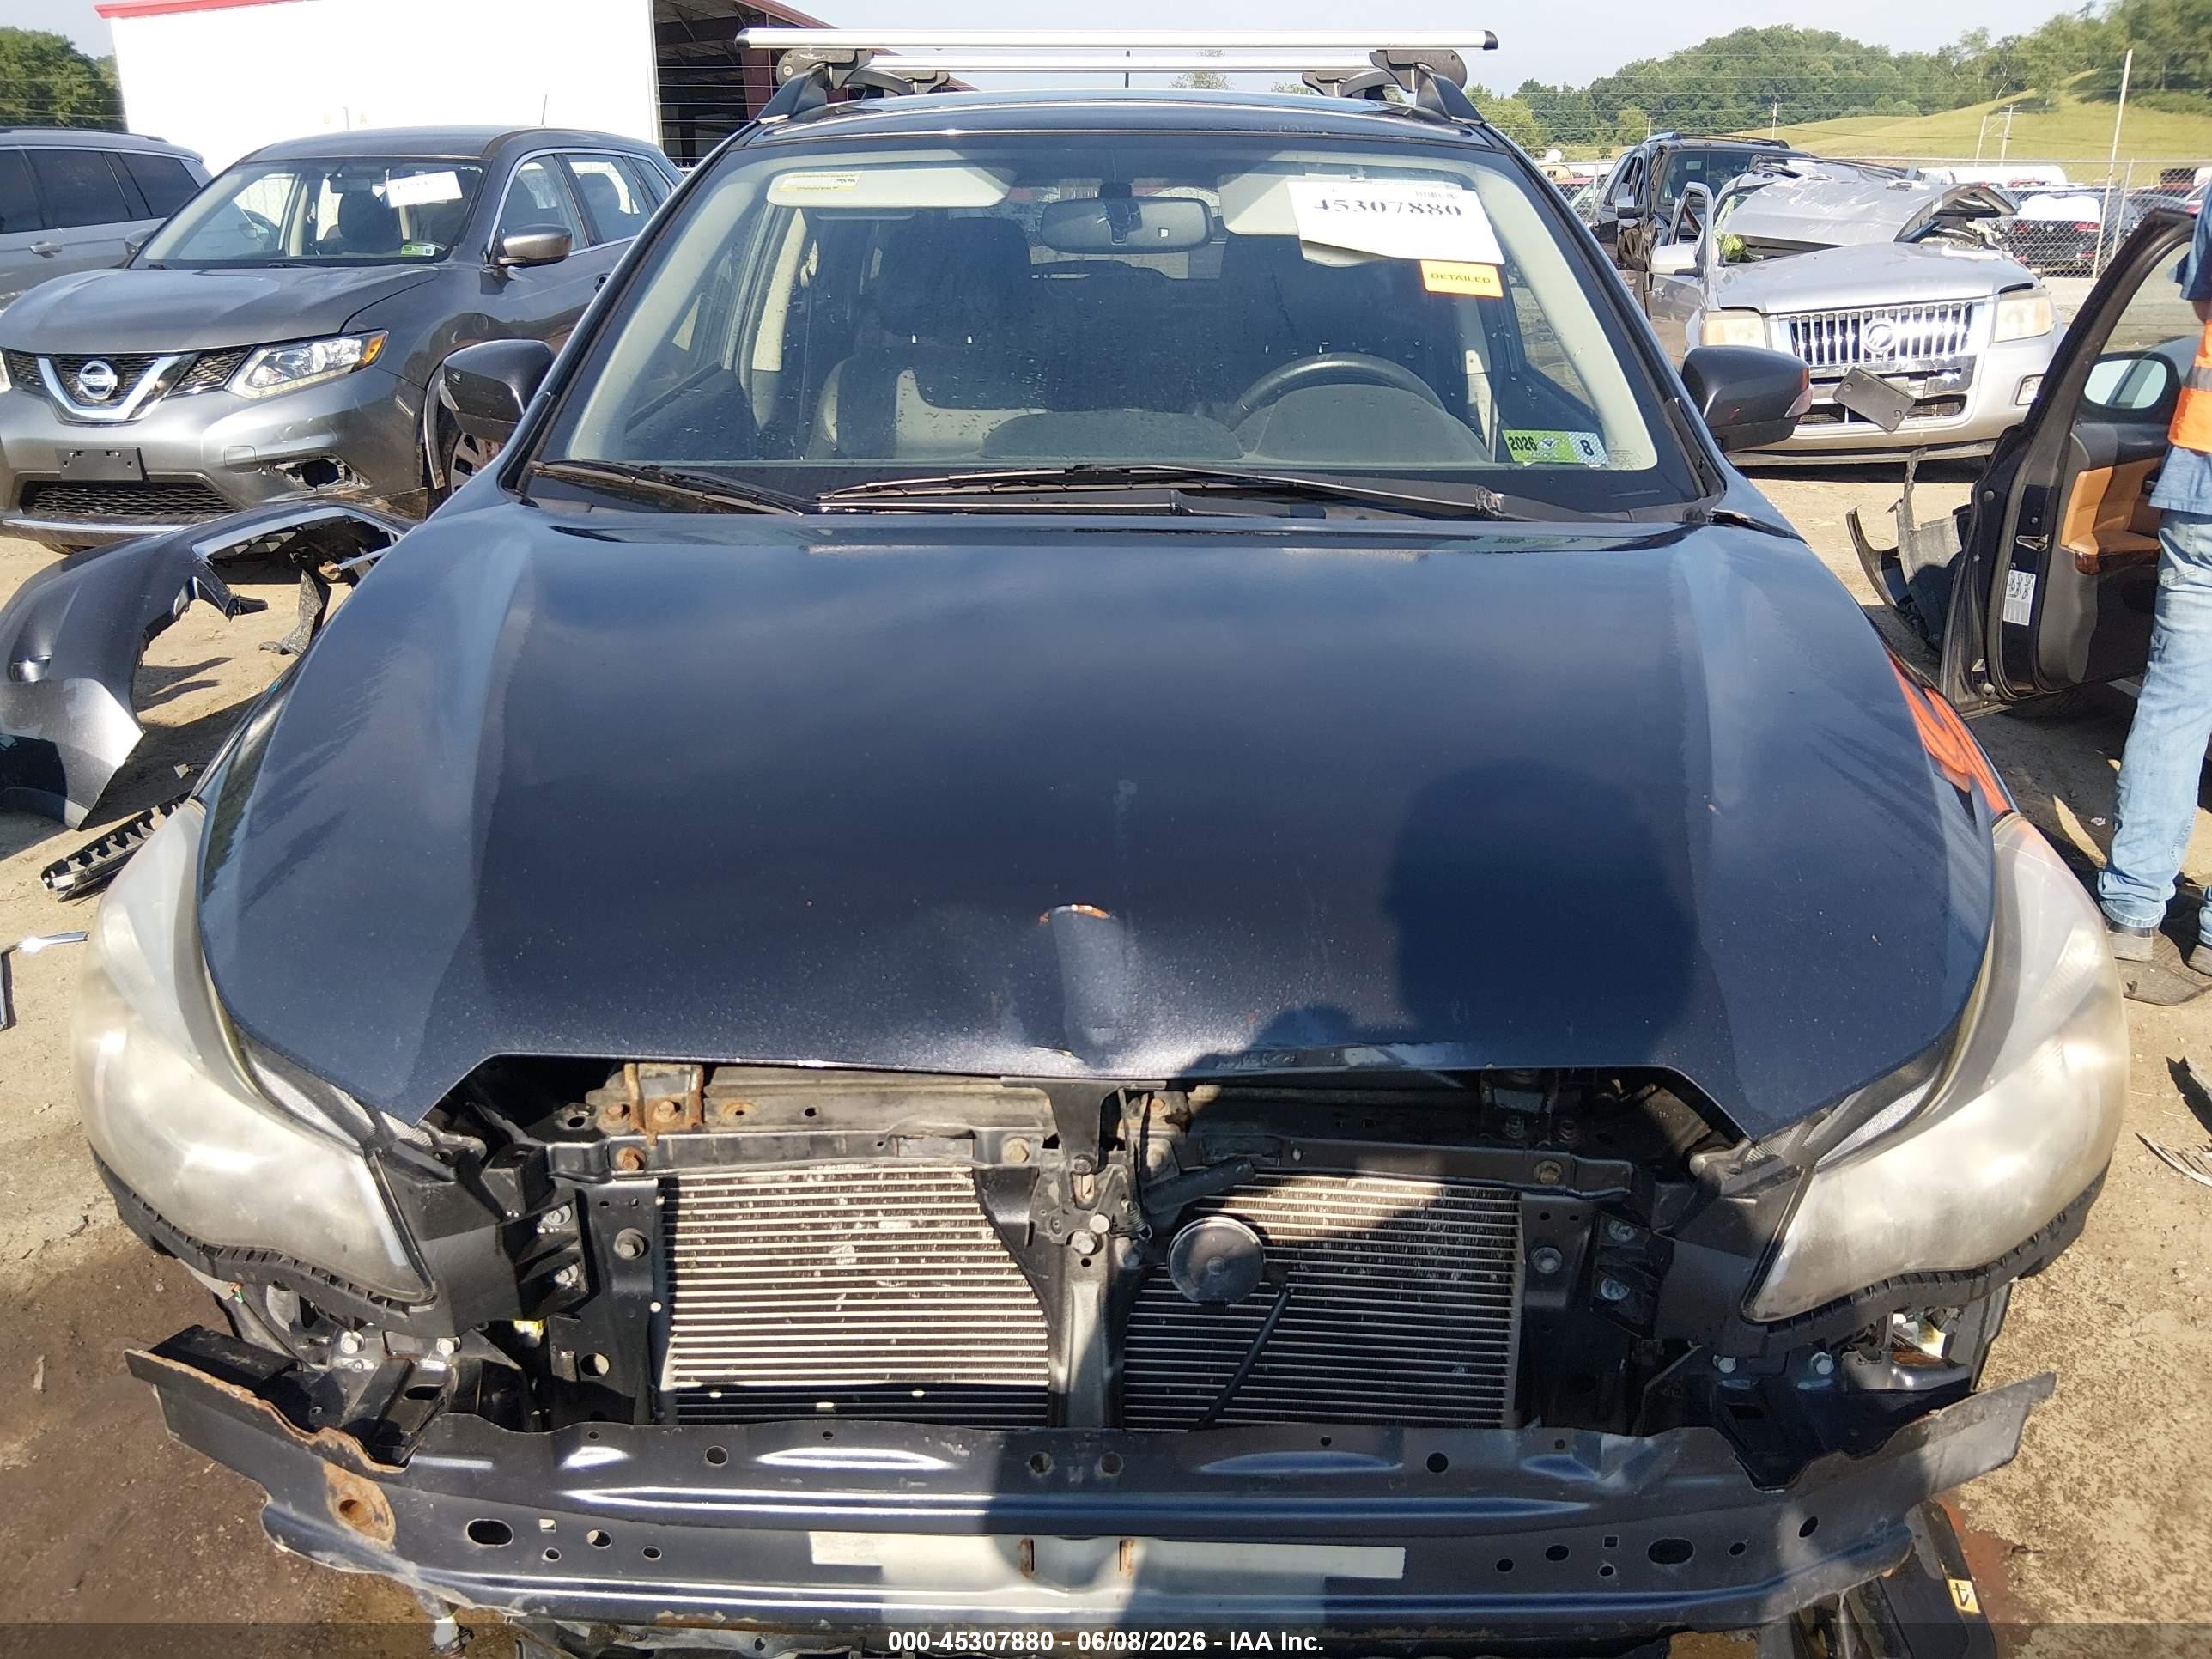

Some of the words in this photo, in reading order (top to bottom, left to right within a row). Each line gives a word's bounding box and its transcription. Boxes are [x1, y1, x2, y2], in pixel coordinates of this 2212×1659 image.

[1314, 198, 1462, 216] 45307880
[1430, 272, 1492, 283] DETAILED
[1508, 436, 1538, 451] 2026
[1579, 439, 1595, 456] 8
